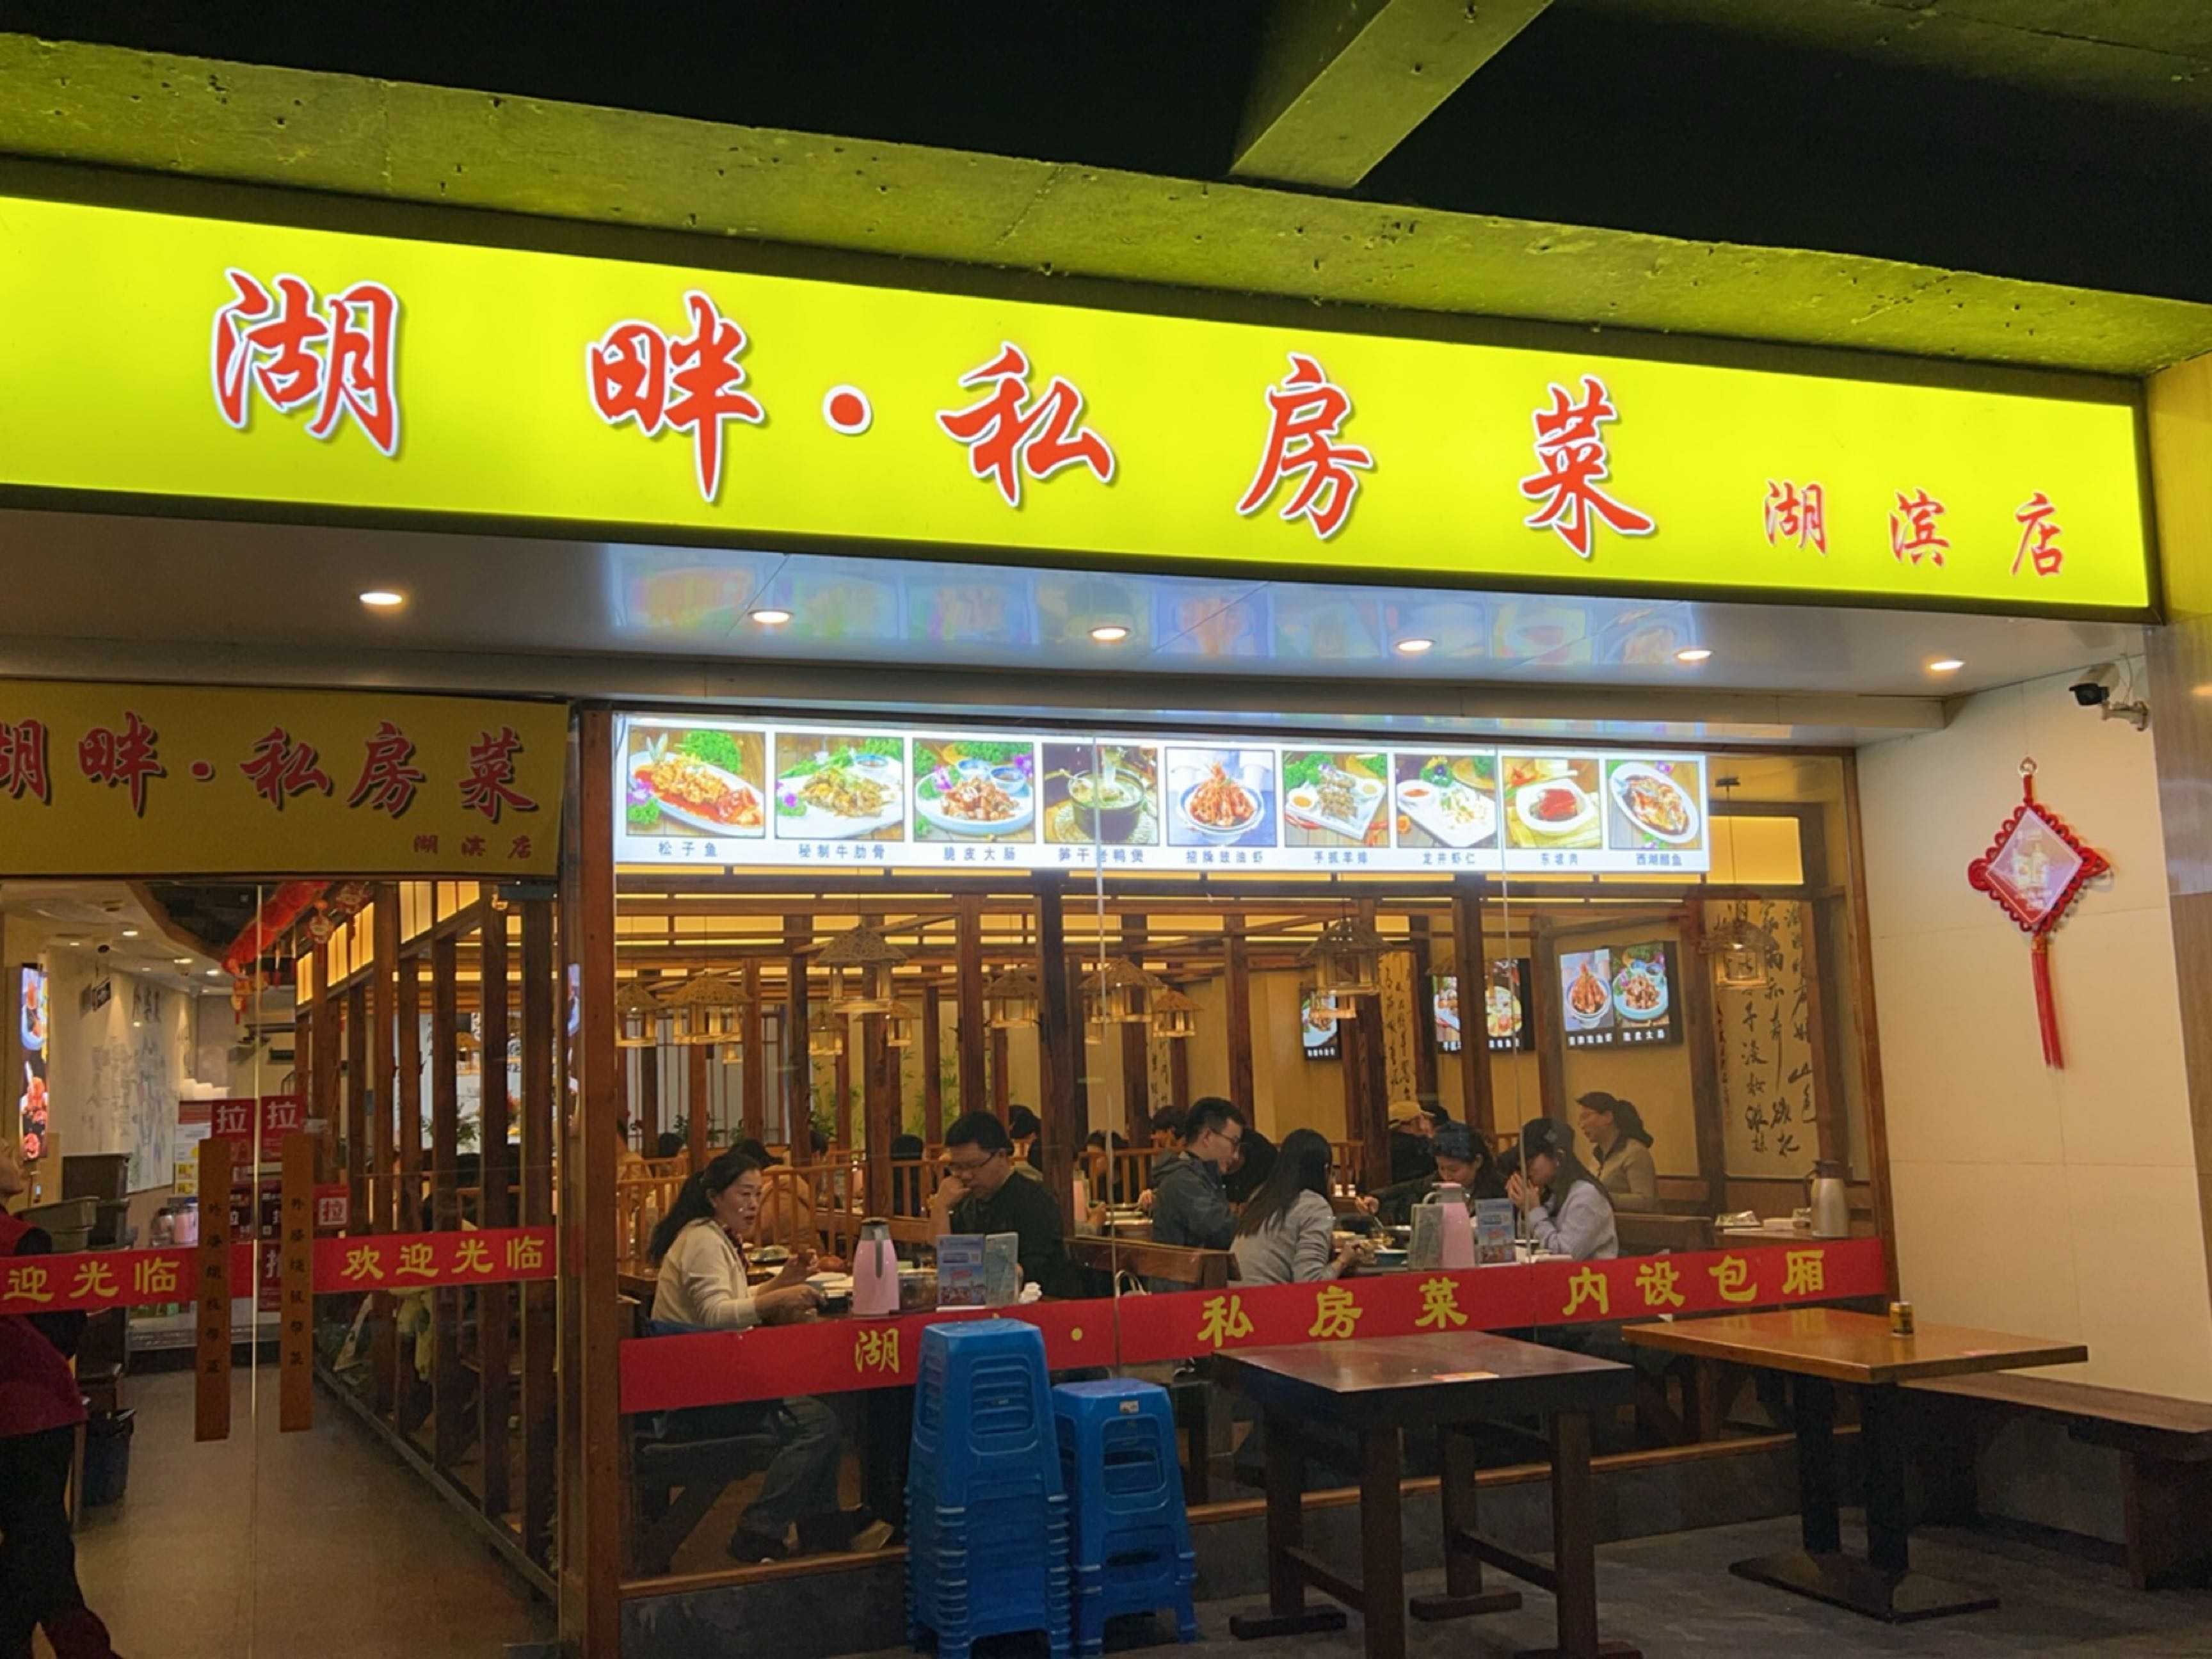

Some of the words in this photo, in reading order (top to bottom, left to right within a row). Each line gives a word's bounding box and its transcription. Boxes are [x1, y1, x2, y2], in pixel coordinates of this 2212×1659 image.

[211, 266, 1656, 557] 湖畔·私房菜
[1763, 479, 2064, 577] 湖滨店
[413, 834, 533, 860] 湖滨店
[658, 841, 717, 858] 松子鱼
[216, 1105, 247, 1134] 拉
[266, 1100, 299, 1130] 拉
[341, 1237, 546, 1280] 欢迎光临
[3, 1256, 181, 1302] 迎光临
[1563, 1249, 1826, 1317] 内设包厢
